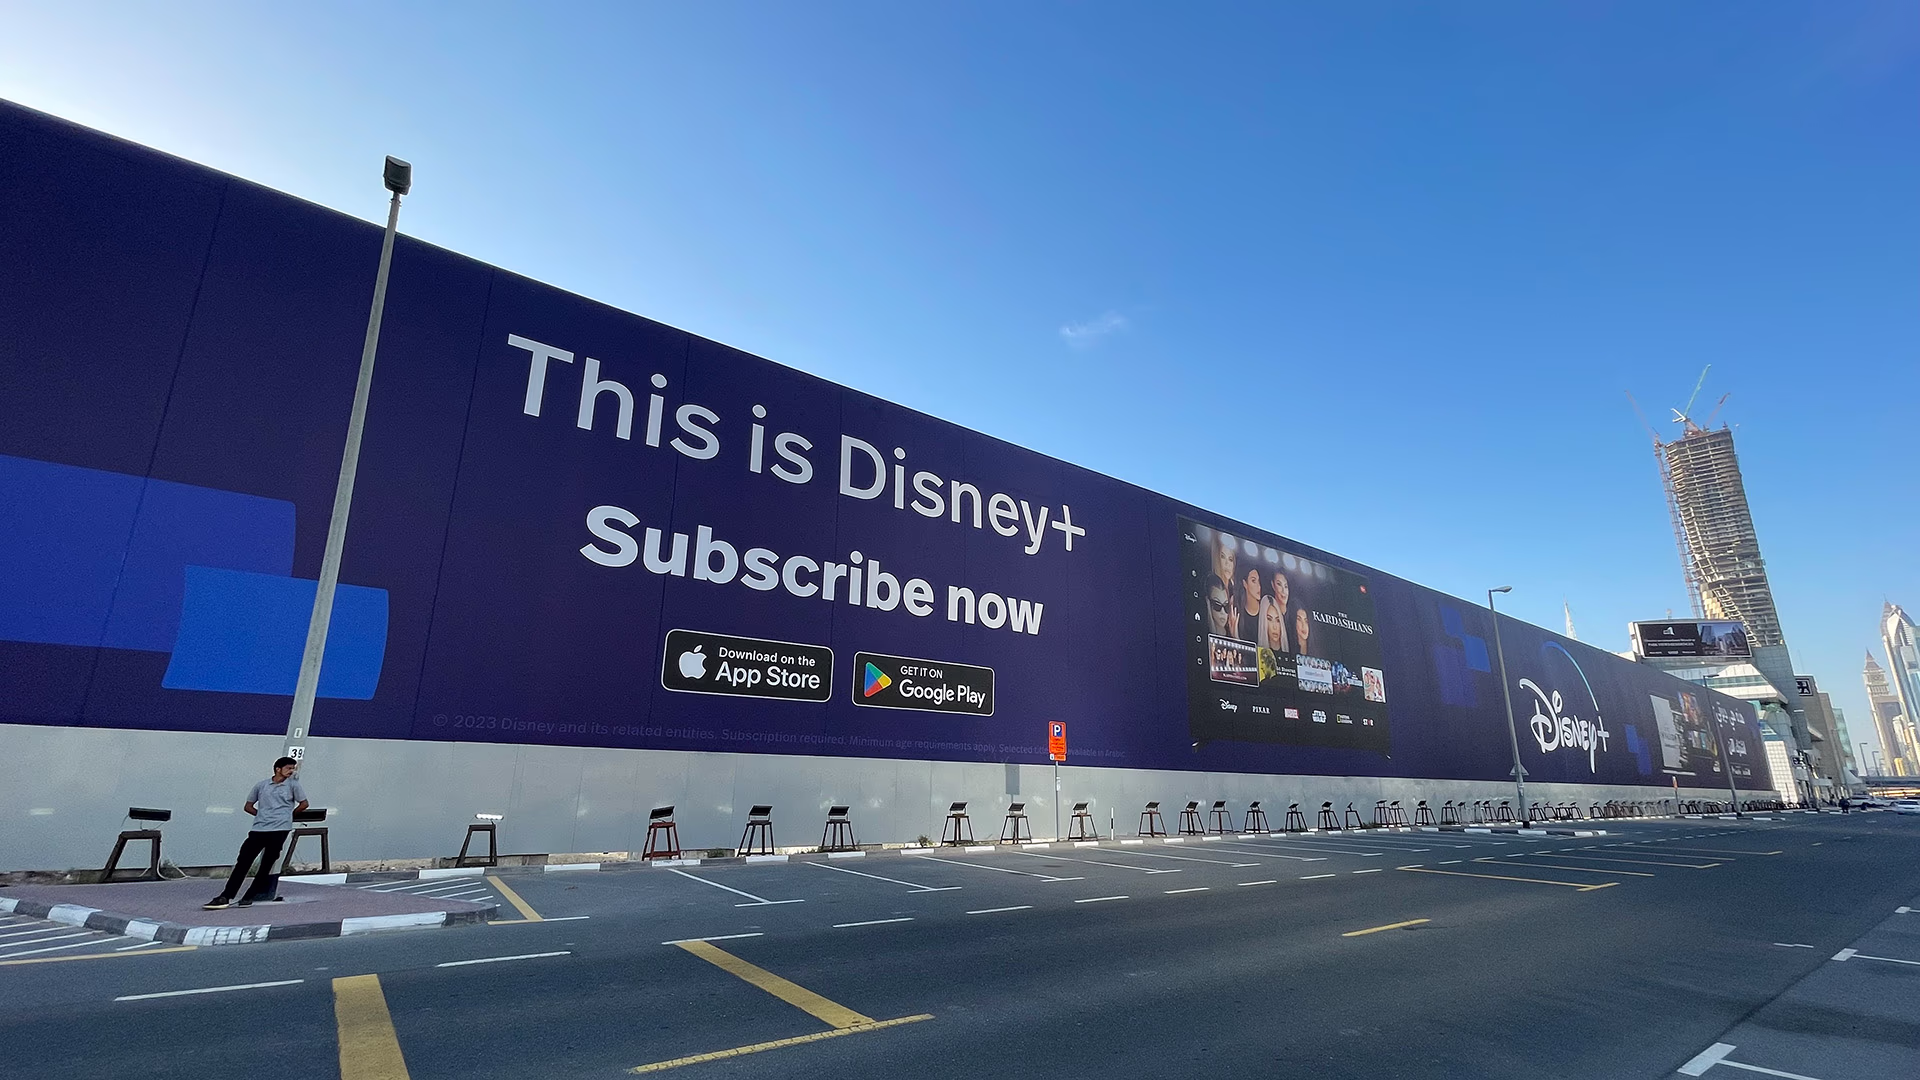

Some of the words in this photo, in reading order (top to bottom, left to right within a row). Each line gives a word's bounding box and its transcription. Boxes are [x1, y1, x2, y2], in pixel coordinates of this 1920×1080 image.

[508, 334, 720, 460] This
[750, 404, 813, 484] is
[839, 434, 1086, 555] Disney+
[579, 505, 934, 617] Subscribe
[947, 585, 1044, 635] now
[1312, 611, 1373, 635] KARDASHIANS
[719, 647, 777, 662] Download
[781, 655, 794, 664] on
[798, 656, 815, 667] the
[715, 661, 761, 688] App
[766, 666, 820, 689] Store
[900, 666, 919, 676] GET
[920, 668, 927, 676] IT
[929, 669, 942, 678] ON
[899, 679, 954, 705] Google
[957, 684, 986, 708] Play
[1252, 706, 1270, 714] PIXAR
[453, 715, 496, 729] 2023
[501, 717, 555, 734] Disney
[558, 722, 587, 733] and
[591, 722, 608, 734] its
[612, 725, 661, 736] related
[722, 729, 796, 743] Subscription
[800, 734, 846, 745] required.
[850, 736, 893, 747] Minimum
[896, 741, 912, 749] age
[915, 740, 972, 751] requirements
[973, 743, 997, 754] apply.
[999, 743, 1032, 754] Selected
[1054, 725, 1061, 736] P
[1519, 678, 1609, 774] Disney+
[291, 749, 302, 758] 39
